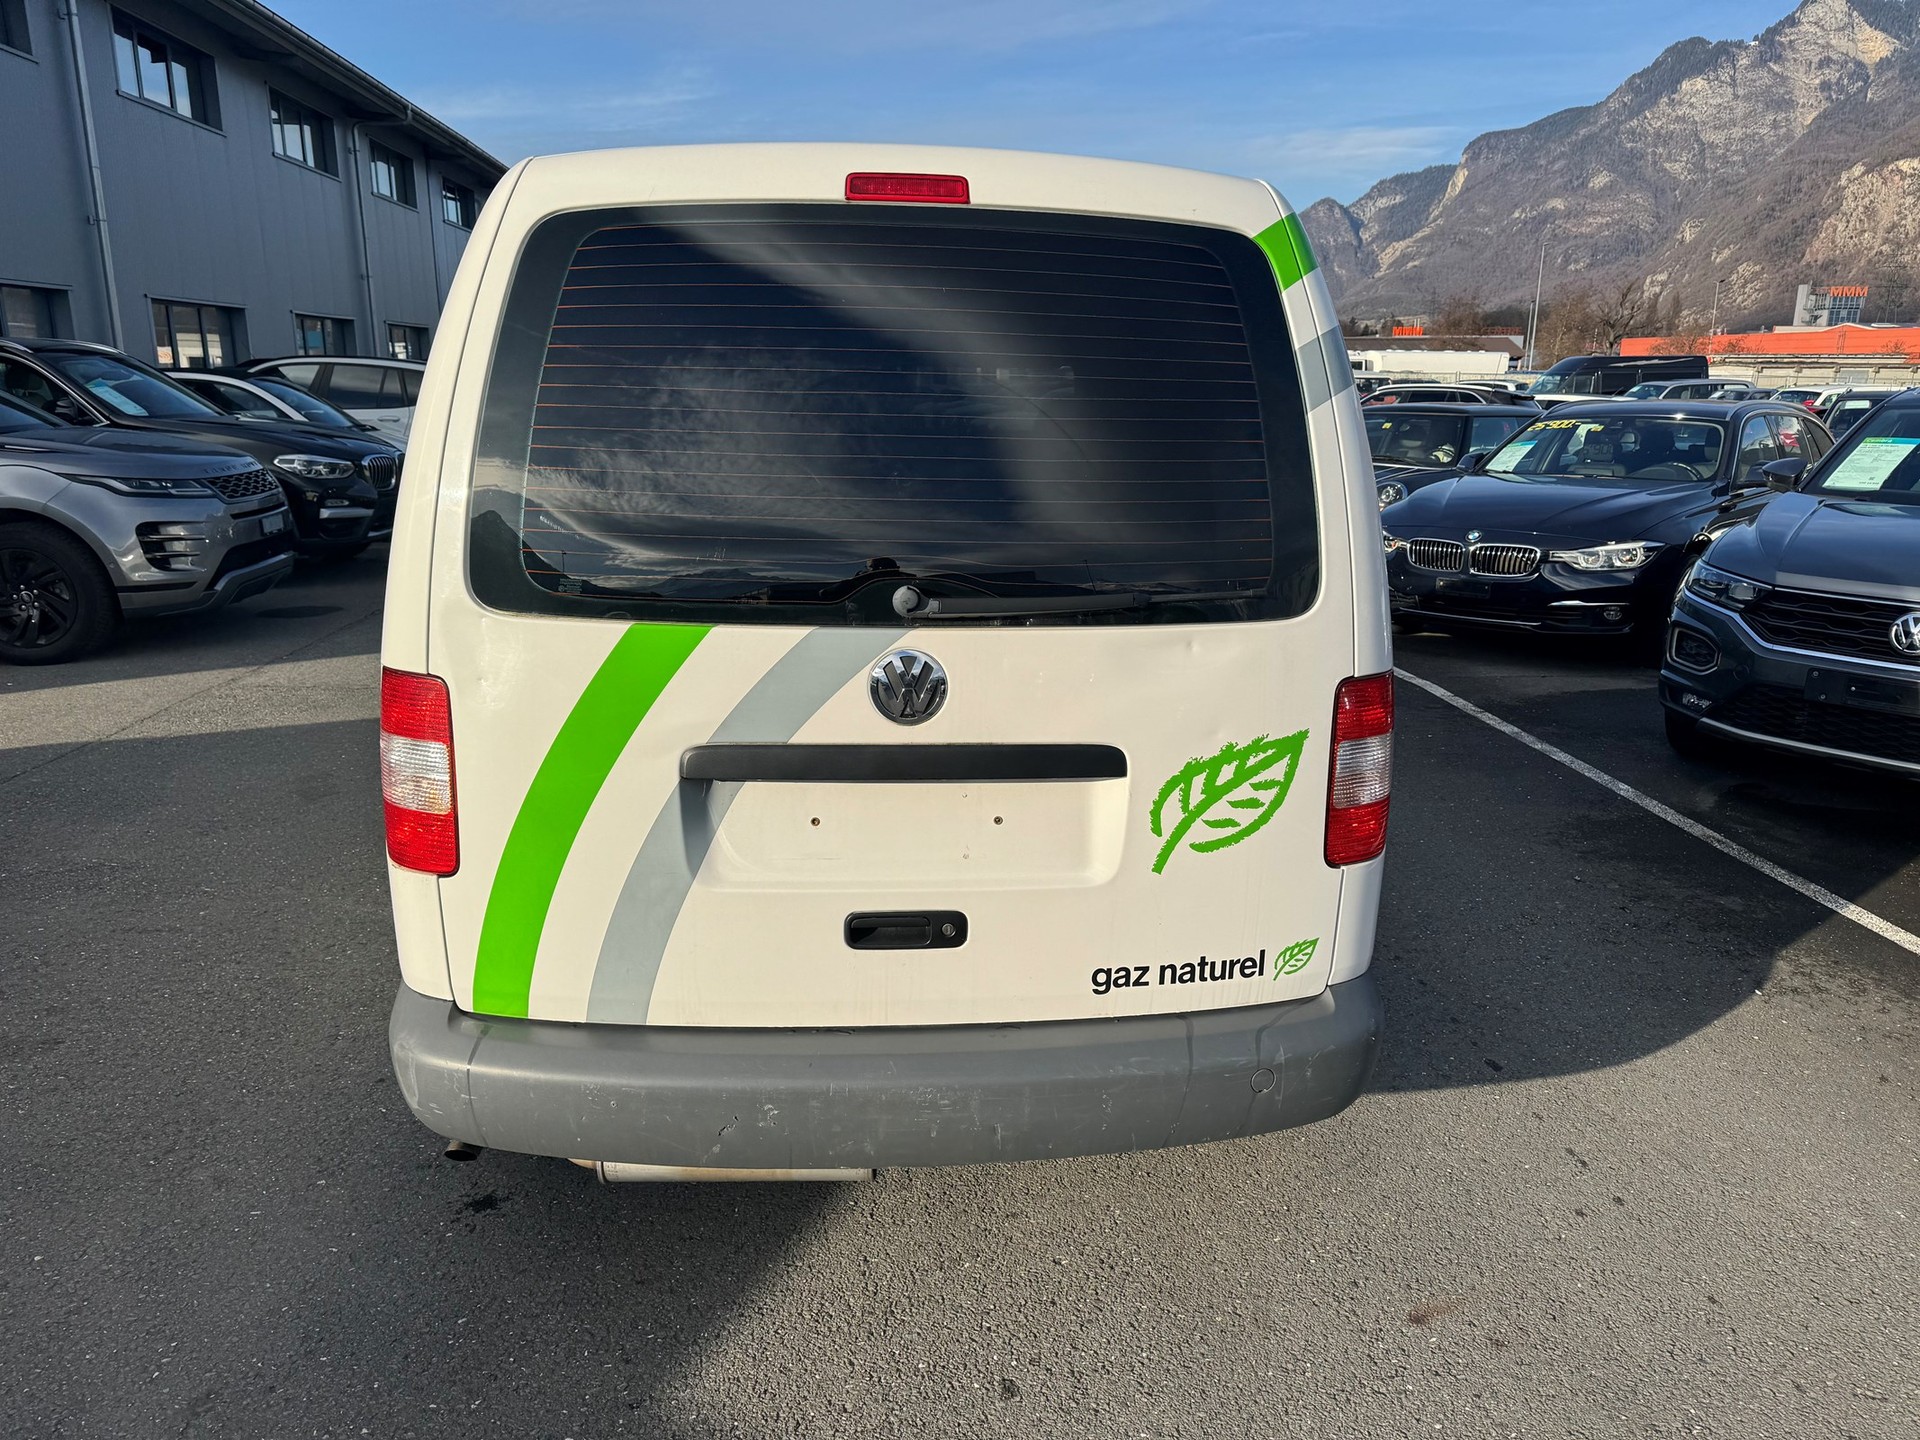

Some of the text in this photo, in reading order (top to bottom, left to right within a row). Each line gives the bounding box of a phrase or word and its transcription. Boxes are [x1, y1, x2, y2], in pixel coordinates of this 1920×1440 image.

[1829, 286, 1869, 297] MMM
[1392, 326, 1424, 336] MMM
[1091, 949, 1266, 995] gaz naturel
